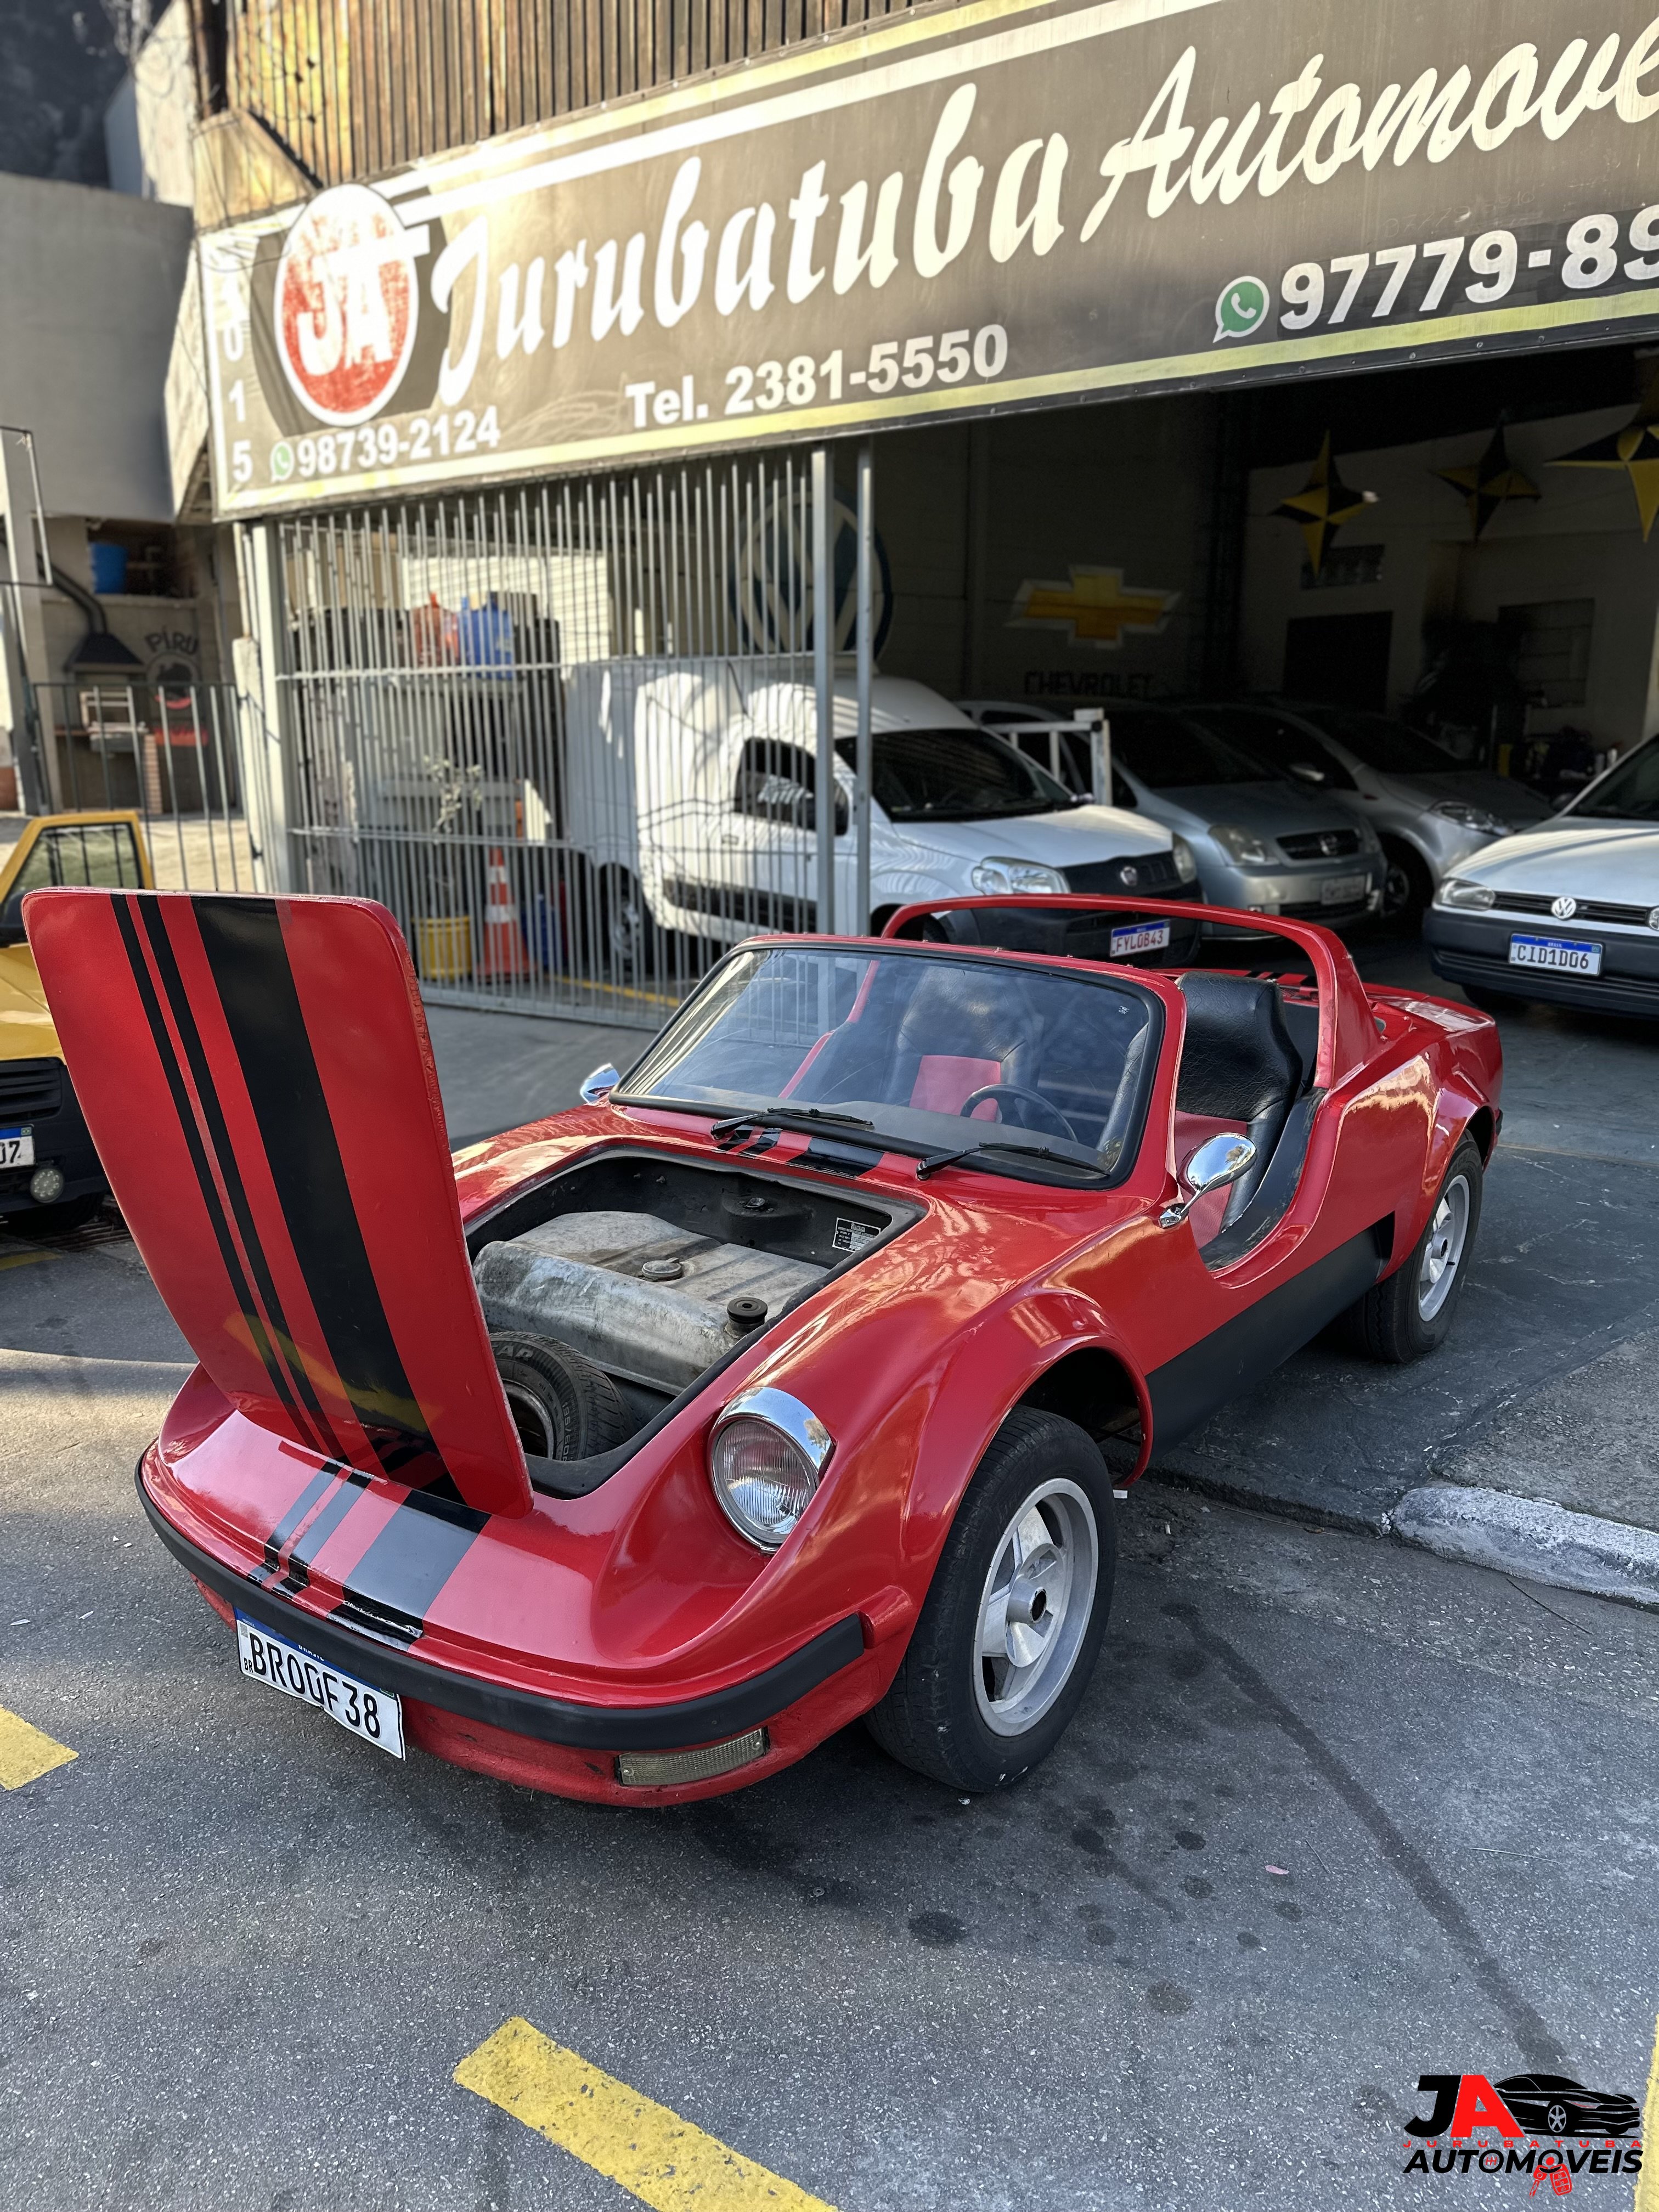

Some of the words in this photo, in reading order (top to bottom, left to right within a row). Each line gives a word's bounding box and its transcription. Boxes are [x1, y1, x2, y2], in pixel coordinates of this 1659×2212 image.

[431, 83, 1069, 407] Jurubatuba
[625, 374, 708, 429] Tel.
[725, 324, 1008, 416] 2381-5550
[297, 406, 500, 477] 98739-2124
[1517, 945, 1589, 969] CID1D06
